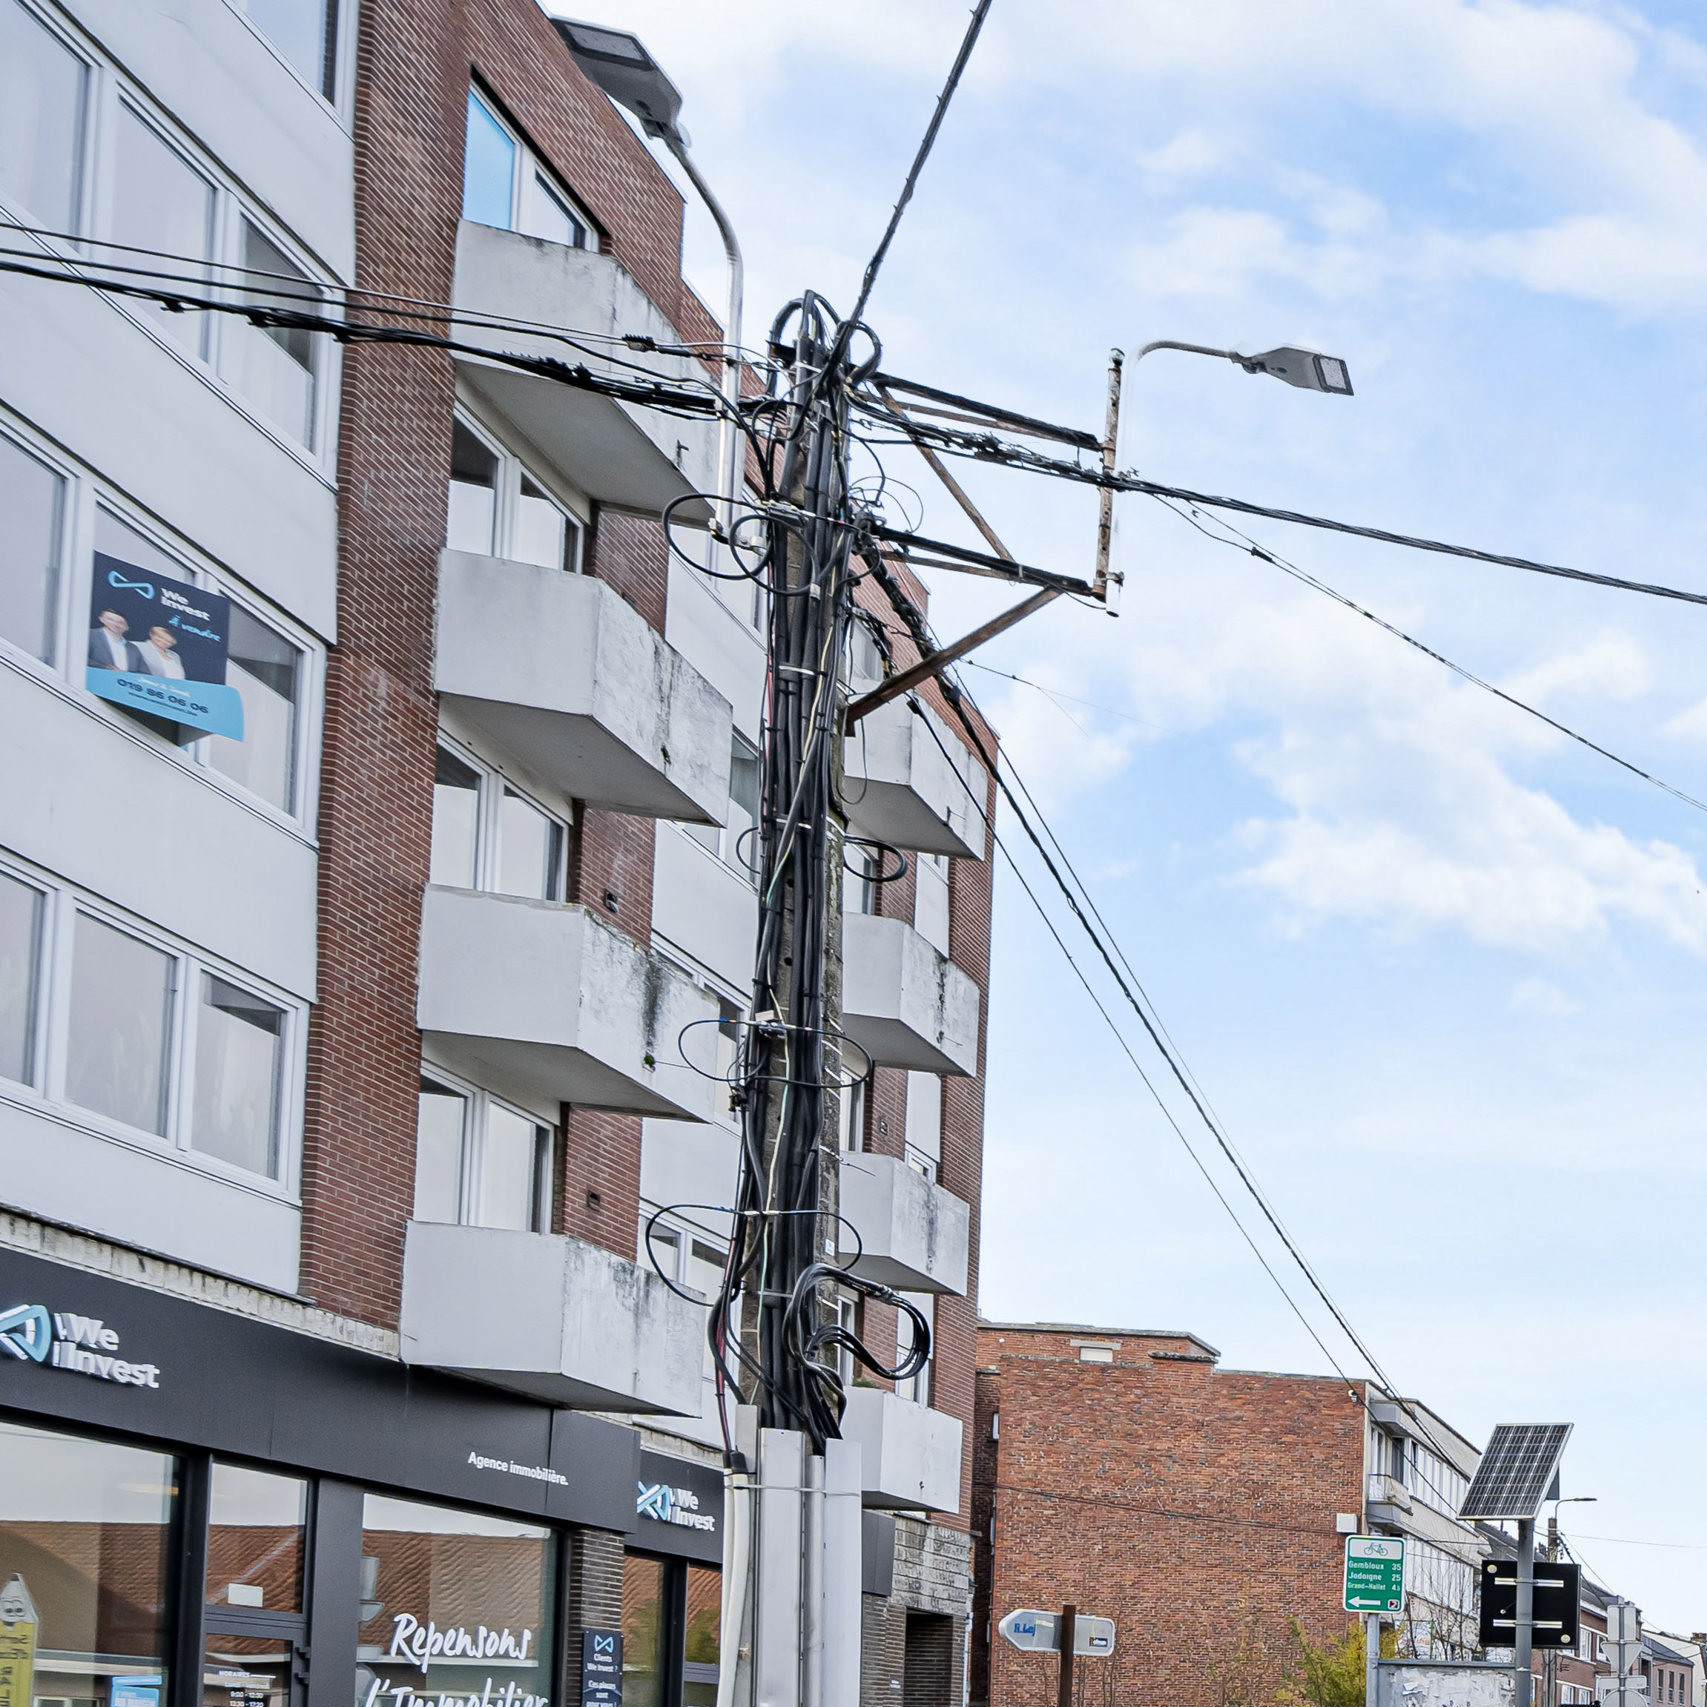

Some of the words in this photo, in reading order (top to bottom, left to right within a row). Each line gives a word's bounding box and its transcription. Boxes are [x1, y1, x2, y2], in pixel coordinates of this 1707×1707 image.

[161, 587, 189, 606] We
[161, 596, 210, 621] Invest
[116, 678, 144, 693] 019
[190, 702, 209, 714] 06
[53, 1313, 119, 1351] We
[52, 1341, 160, 1389] Invest
[467, 1451, 508, 1469] Agence
[668, 1487, 699, 1510] We
[667, 1505, 715, 1531] Invest
[1348, 1560, 1385, 1570] Gembloux
[1391, 1563, 1402, 1571] 35
[1348, 1571, 1382, 1582] Jodoigne
[1391, 1574, 1402, 1582] 25
[390, 1613, 532, 1674] Repensons
[586, 1662, 597, 1671] We
[593, 1652, 613, 1663] Clients
